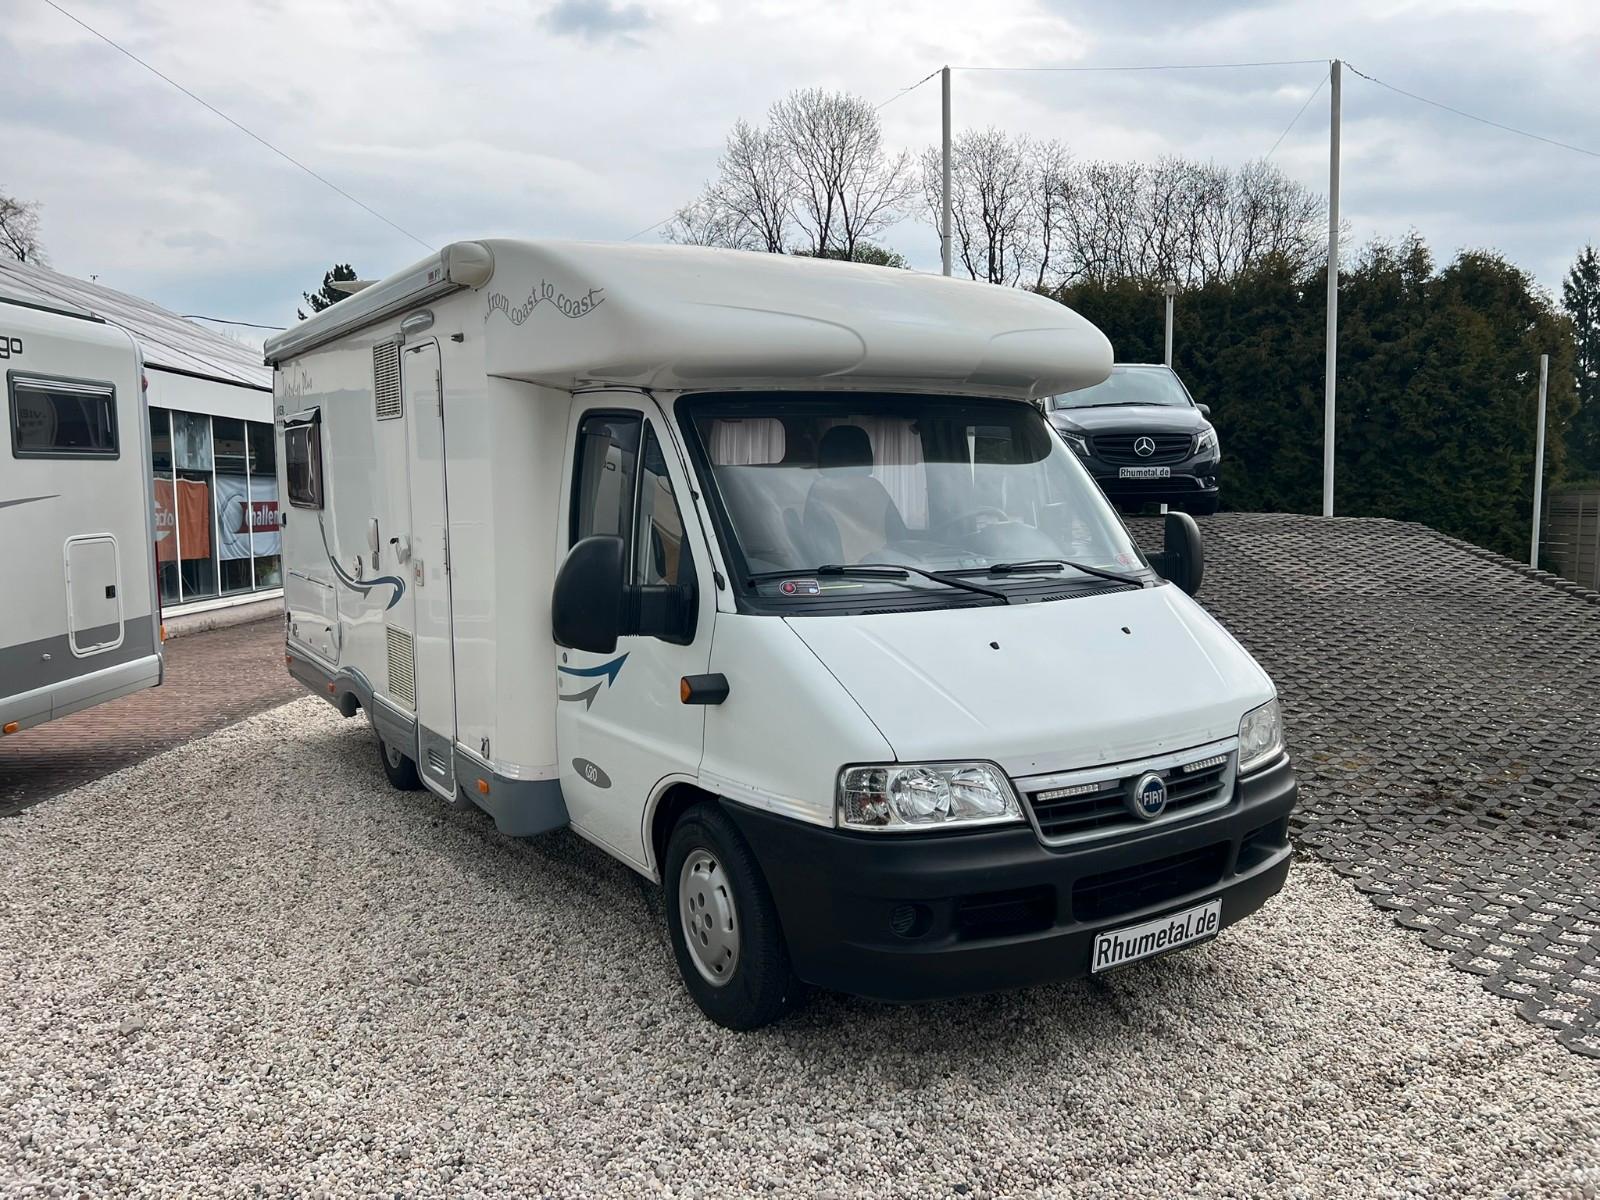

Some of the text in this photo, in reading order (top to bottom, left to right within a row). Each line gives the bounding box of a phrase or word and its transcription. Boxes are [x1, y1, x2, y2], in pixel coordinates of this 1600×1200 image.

[487, 278, 604, 323] from coast to coast
[1120, 468, 1169, 476] Rhumetal.de
[585, 763, 598, 782] 620
[1143, 789, 1163, 806] FIAT
[1097, 908, 1217, 967] Rhumetal.de
